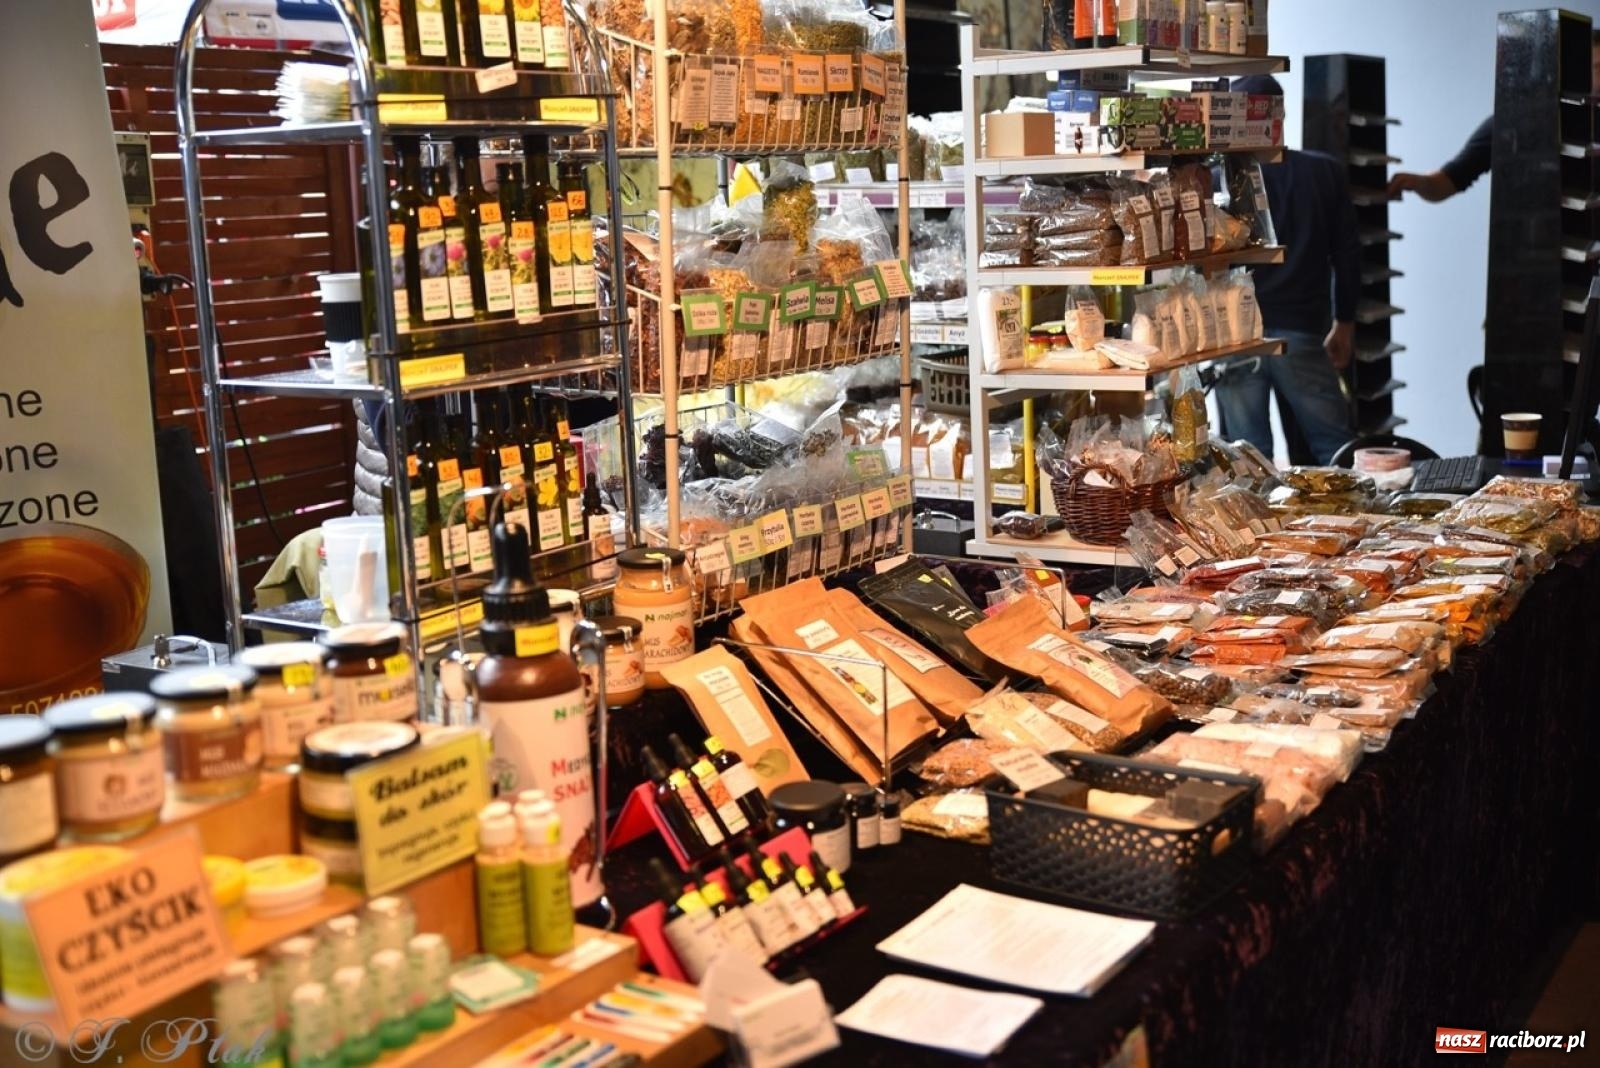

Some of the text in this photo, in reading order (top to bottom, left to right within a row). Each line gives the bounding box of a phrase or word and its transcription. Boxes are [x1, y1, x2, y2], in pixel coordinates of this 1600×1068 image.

[0, 442, 58, 473] ne
[553, 774, 591, 802] SNA
[85, 866, 157, 918] EKO
[57, 885, 202, 973] CZYŚCIK
